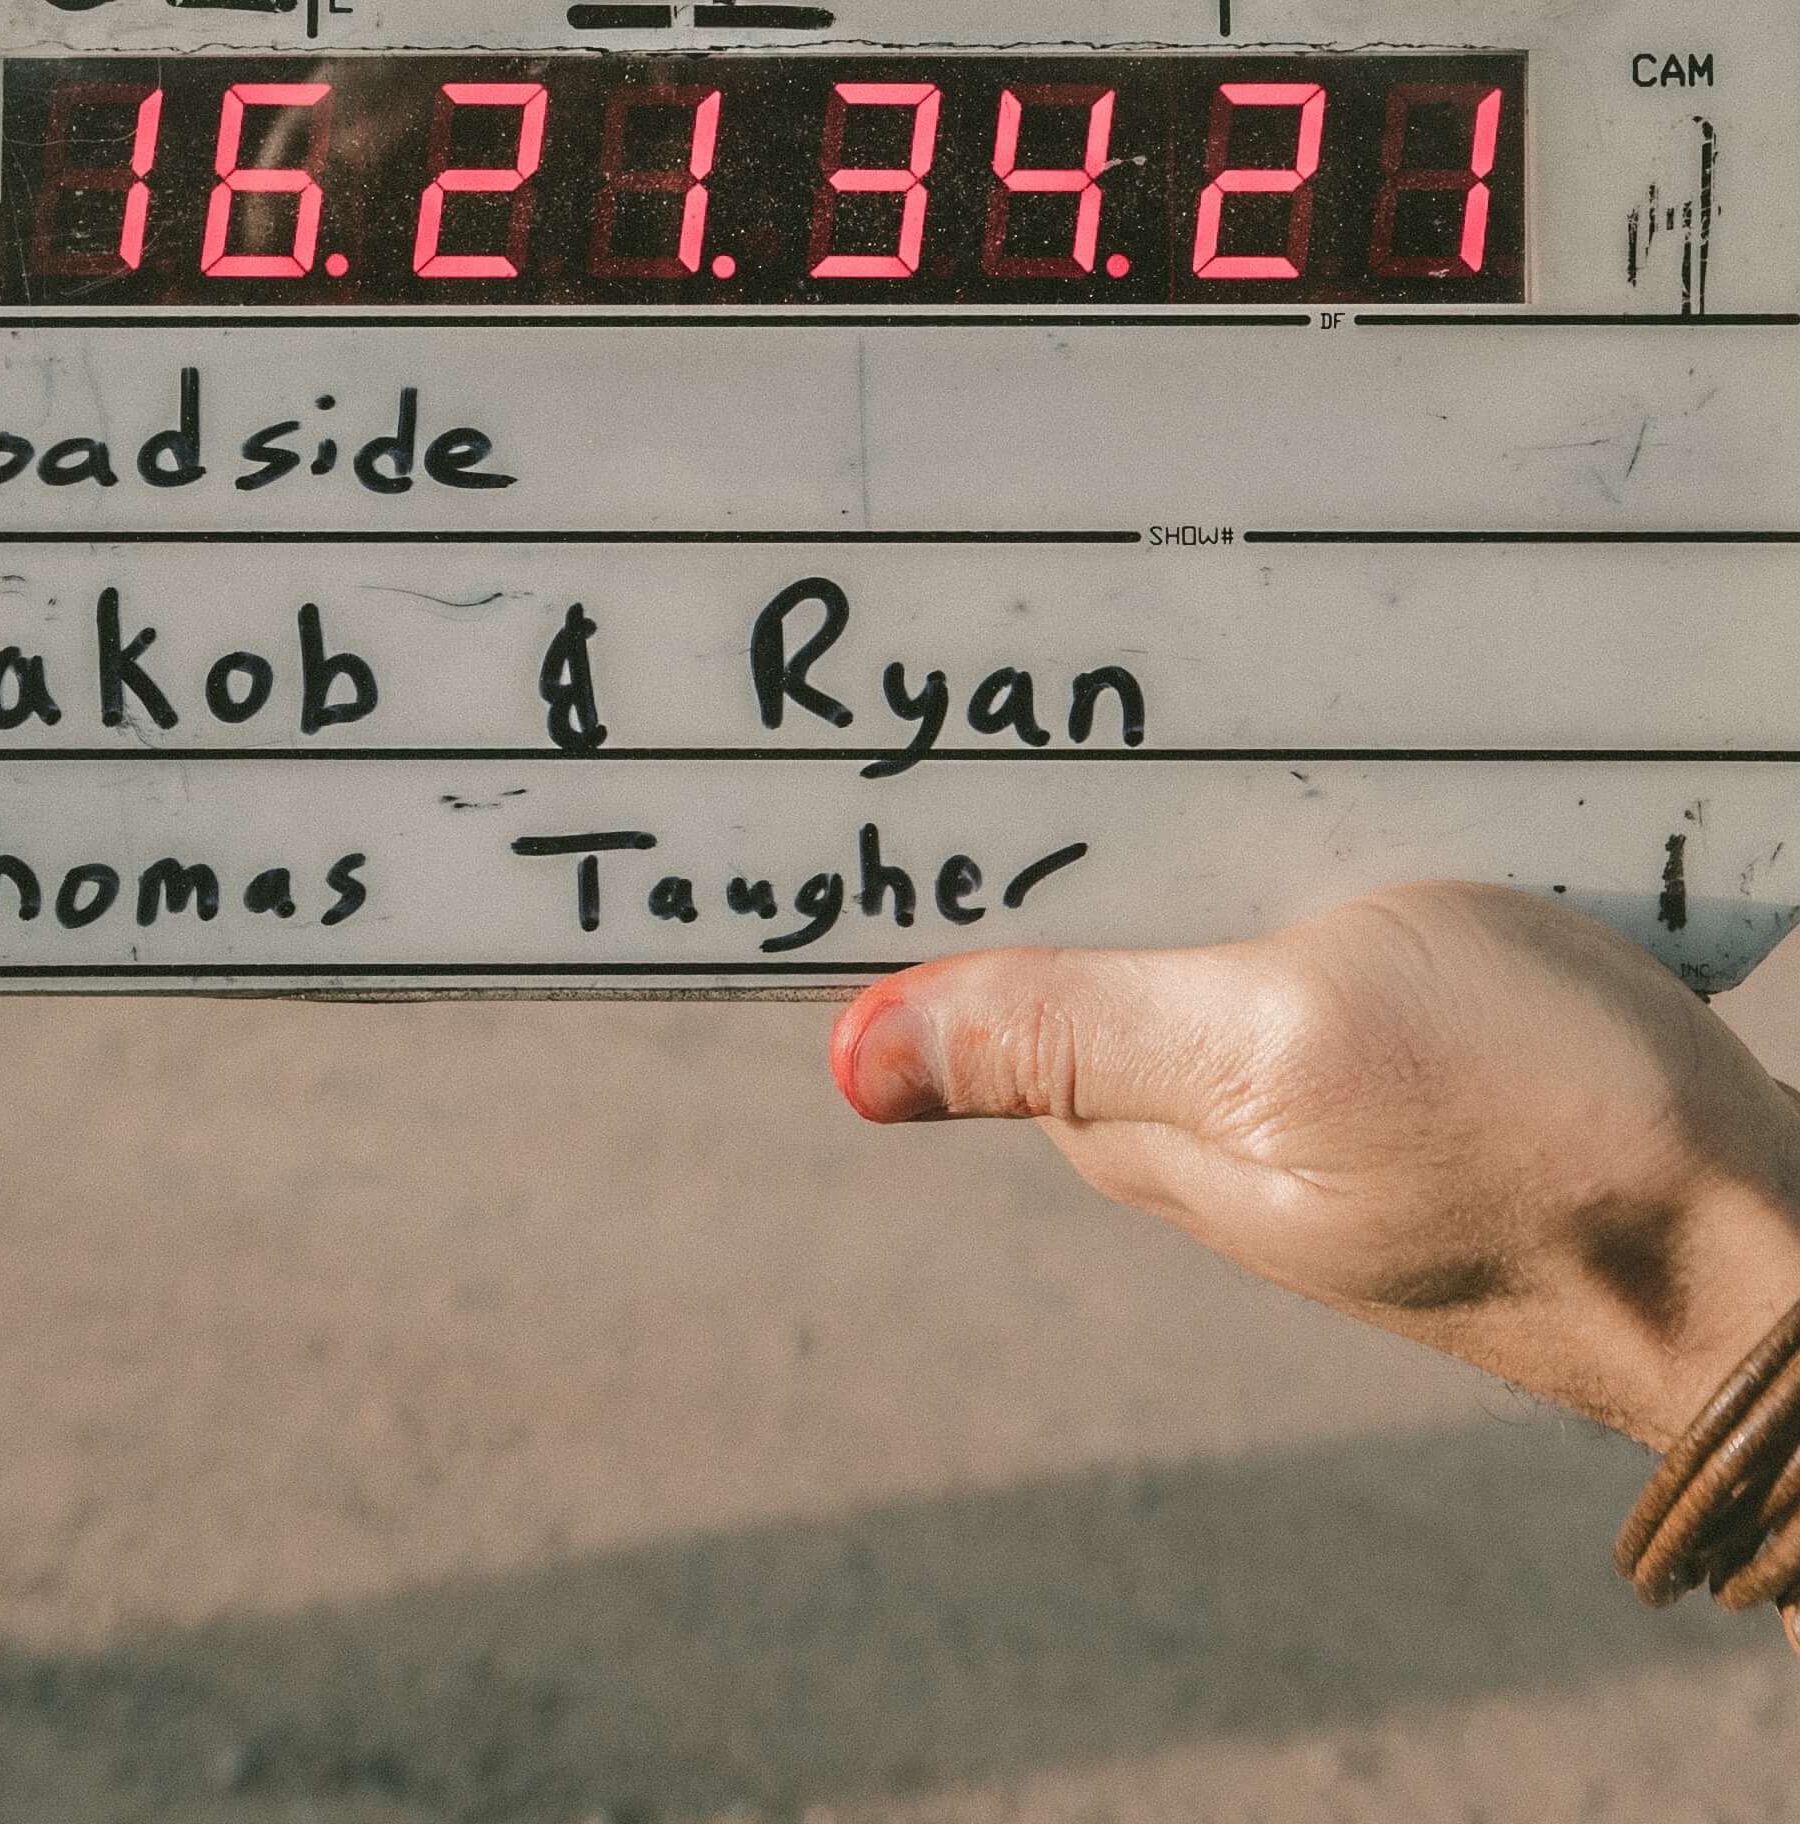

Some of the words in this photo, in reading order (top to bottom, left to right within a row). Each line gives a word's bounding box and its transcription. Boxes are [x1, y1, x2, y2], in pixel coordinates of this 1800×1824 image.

[1632, 53, 1714, 88] CAM
[1320, 312, 1346, 330] DF
[1149, 525, 1235, 547] SHOW#
[749, 576, 1145, 778] Ryan
[511, 822, 1089, 953] Taugher
